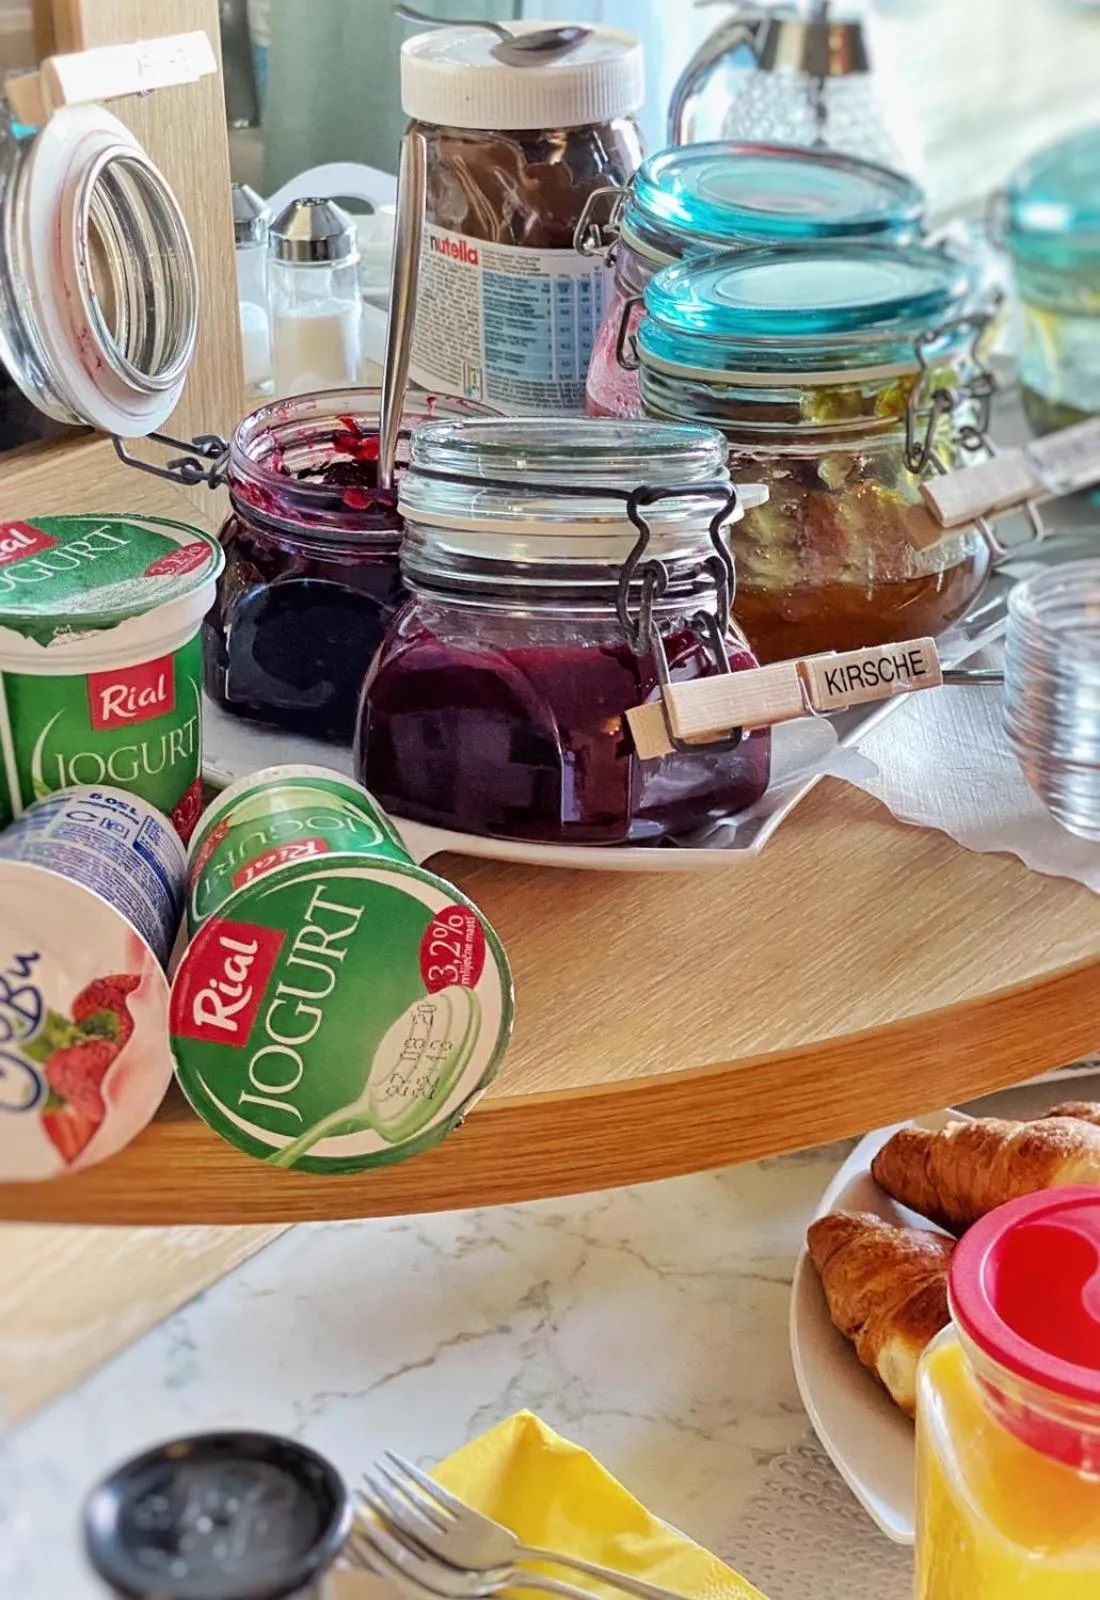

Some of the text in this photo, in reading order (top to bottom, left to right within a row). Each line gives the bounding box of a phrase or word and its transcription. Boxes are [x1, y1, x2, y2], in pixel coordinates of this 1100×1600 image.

[430, 235, 479, 265] nutella
[0, 529, 37, 559] al
[100, 674, 167, 721] Rial
[824, 649, 926, 696] KIRSCHE
[55, 715, 198, 789] JOGURT
[203, 815, 358, 895] JOGURT
[245, 839, 320, 882] Rial
[427, 914, 465, 983] 3,2%
[192, 934, 260, 1033] Rial
[238, 884, 366, 1123] JOGURT
